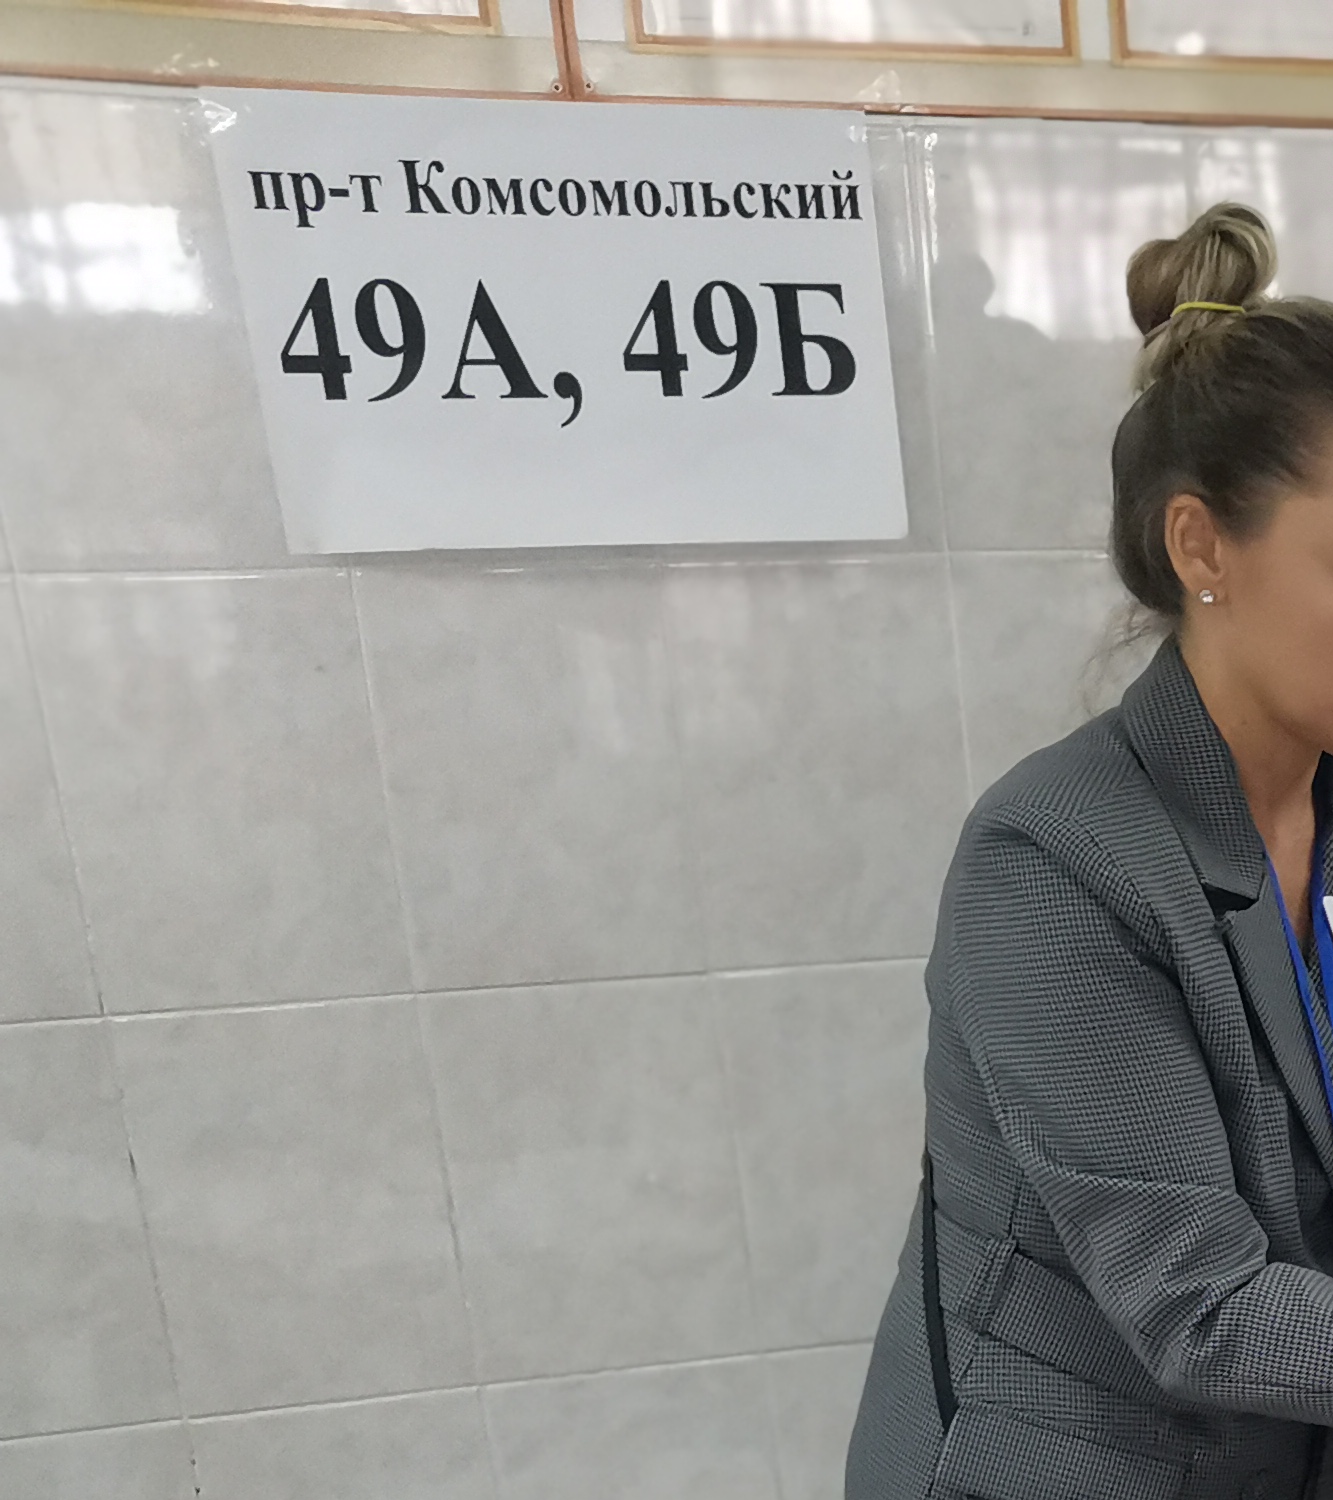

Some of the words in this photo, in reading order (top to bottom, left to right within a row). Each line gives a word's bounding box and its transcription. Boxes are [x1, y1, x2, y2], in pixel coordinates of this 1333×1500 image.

[247, 168, 382, 228] пр-т
[398, 159, 864, 221] Комсомольский
[280, 276, 583, 428] 49А,
[622, 278, 857, 399] 49Б
